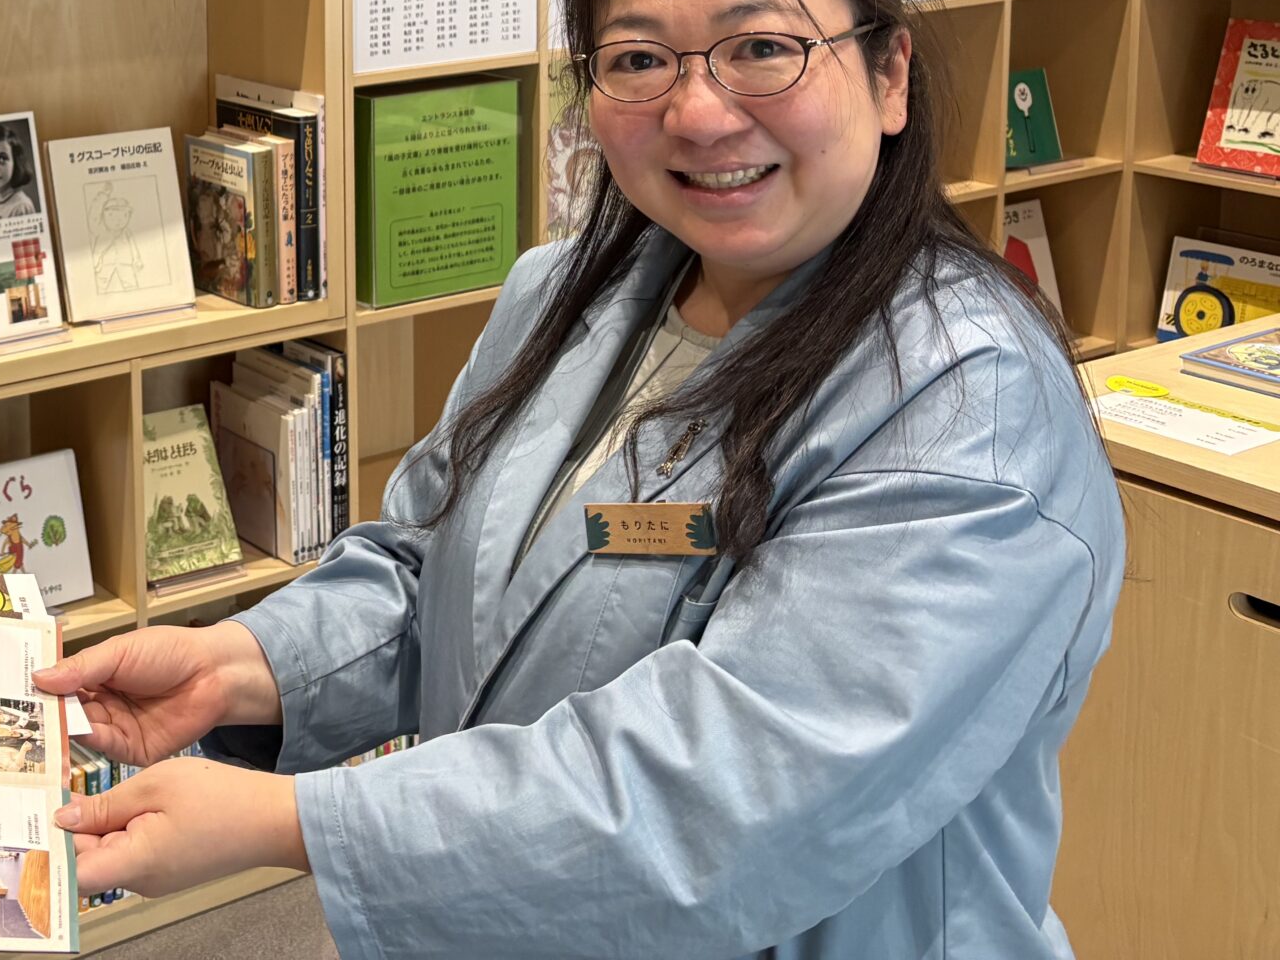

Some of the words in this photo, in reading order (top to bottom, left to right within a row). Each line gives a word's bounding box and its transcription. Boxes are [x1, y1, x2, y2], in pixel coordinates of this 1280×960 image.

[77, 142, 163, 162] グスコーブドリの伝記
[306, 213, 313, 224] 2
[333, 409, 348, 487] 進化の記録
[620, 520, 670, 531] もりたに
